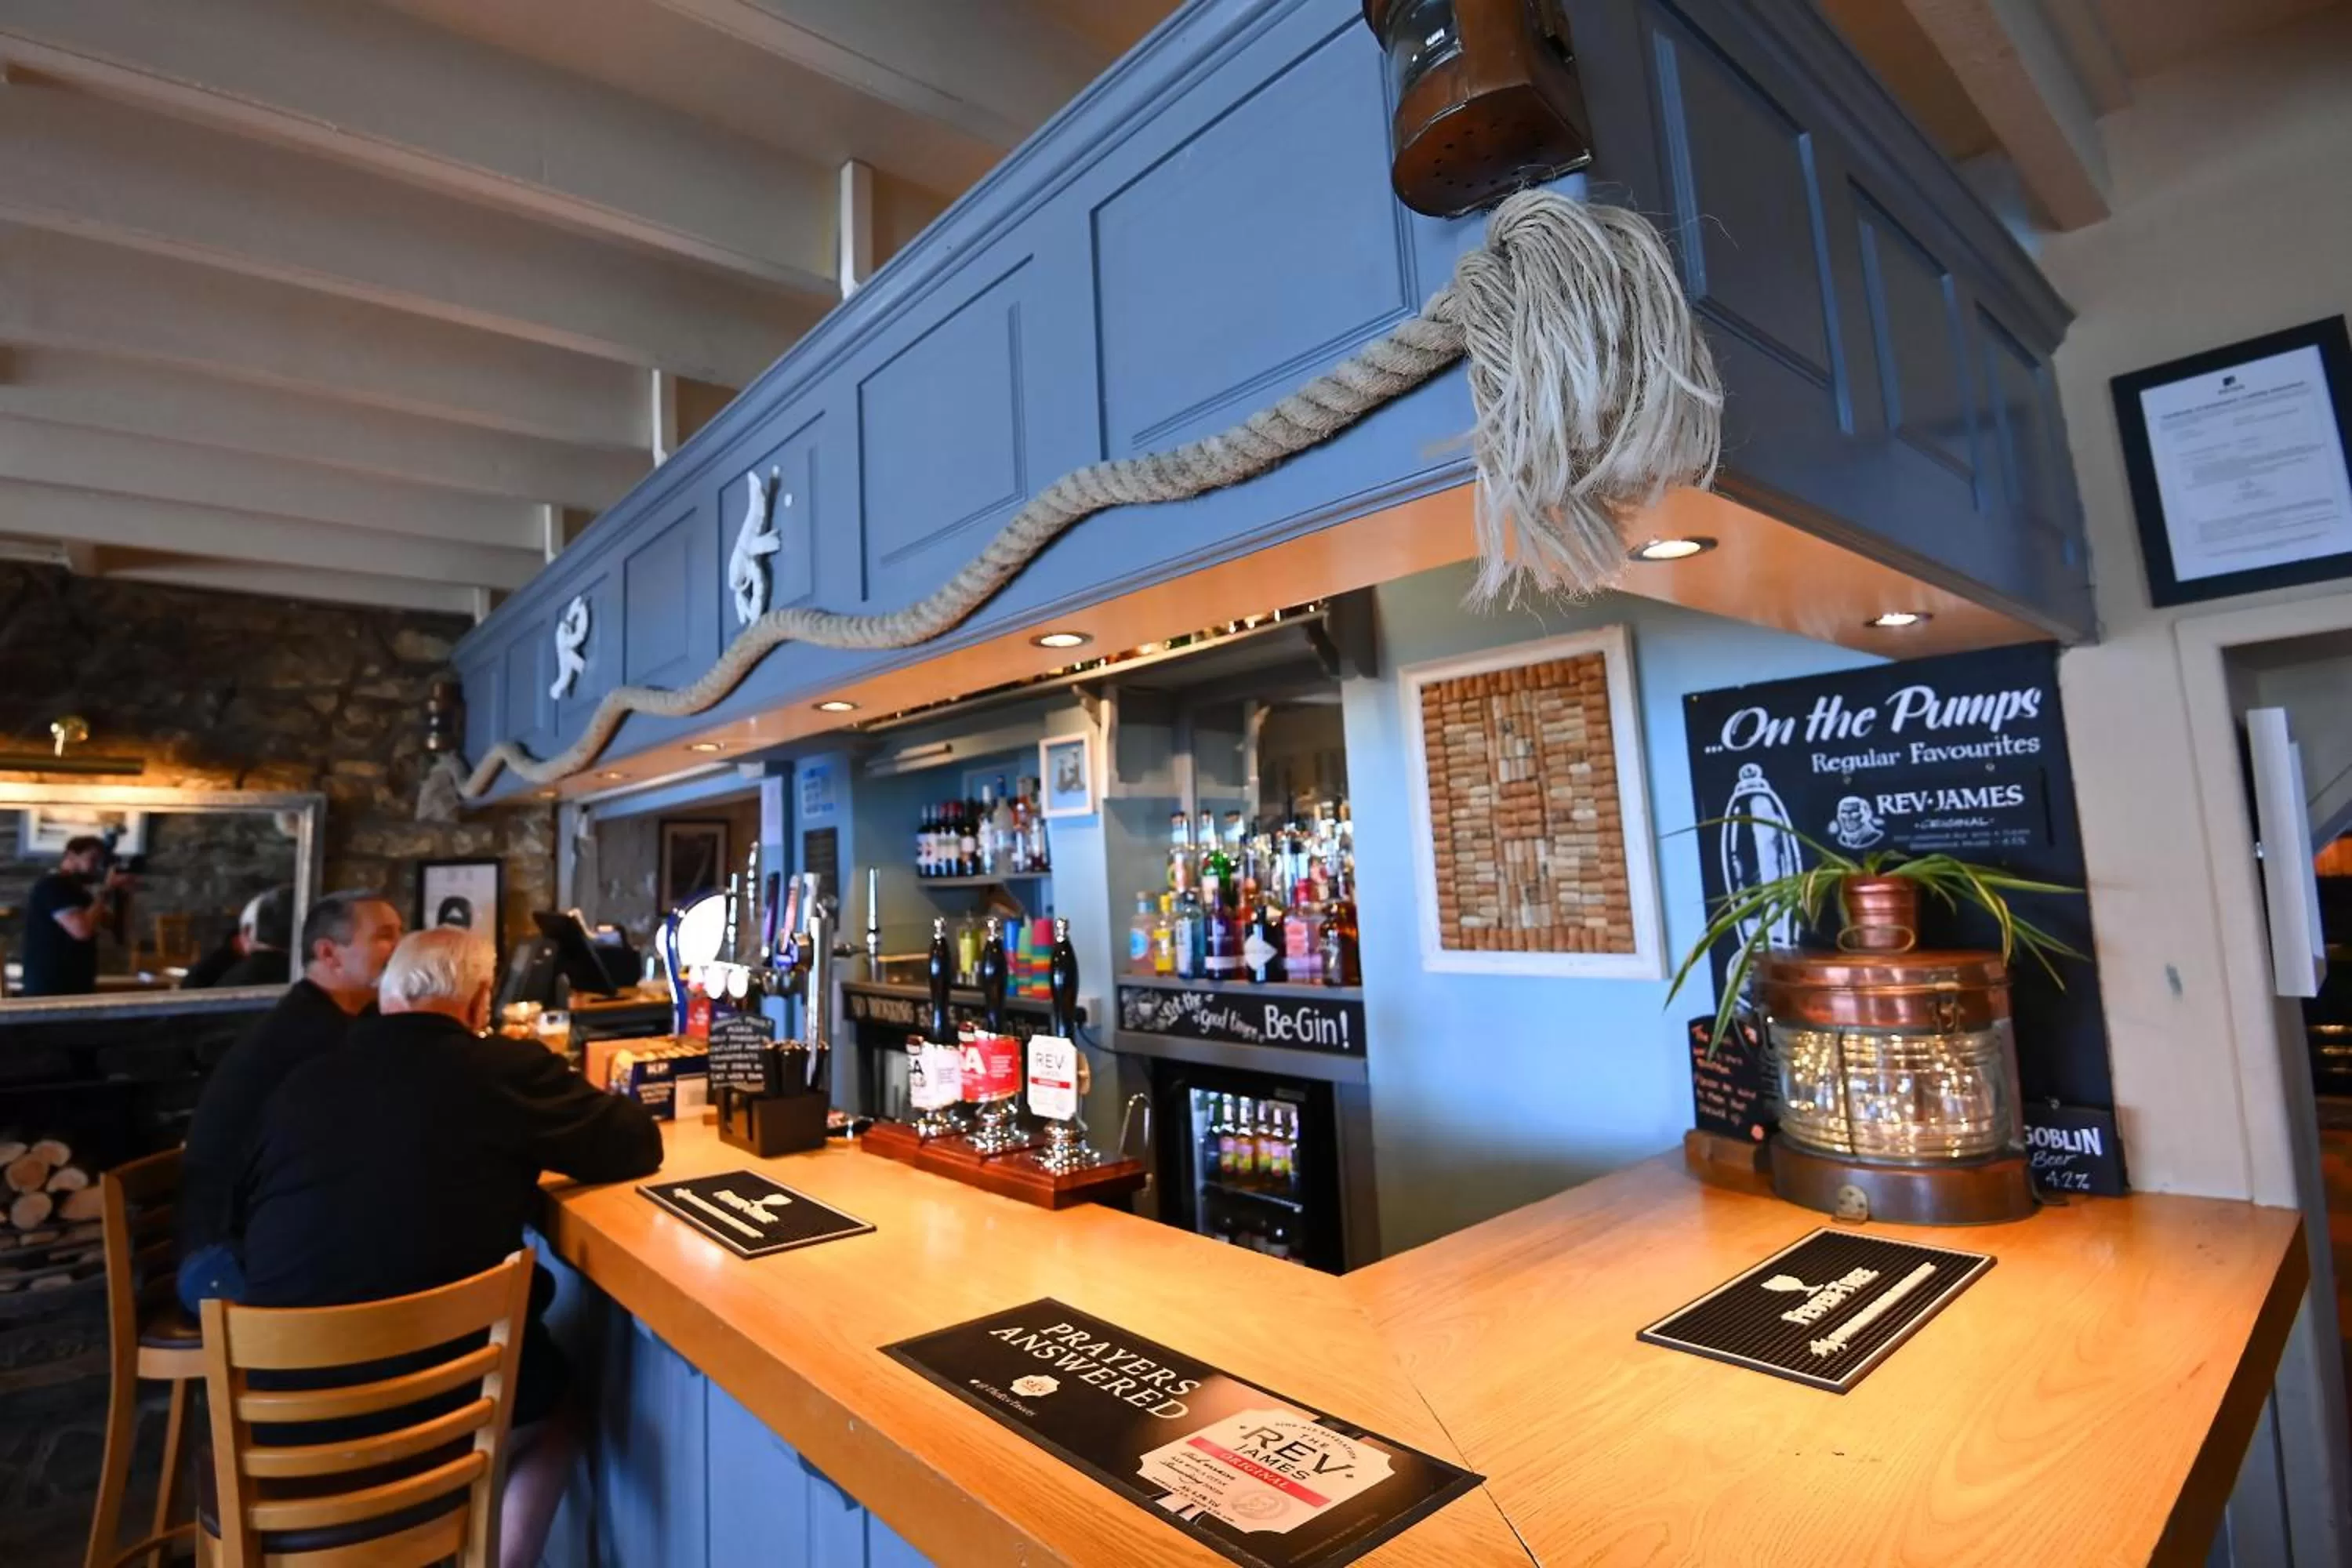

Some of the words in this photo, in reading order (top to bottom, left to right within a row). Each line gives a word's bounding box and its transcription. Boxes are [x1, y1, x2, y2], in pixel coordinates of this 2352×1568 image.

[1805, 695, 1877, 743] the
[1886, 685, 2042, 732] Pumps
[1812, 750, 1900, 774] Regular
[1910, 735, 2040, 765] Favourites
[1036, 1052, 1065, 1070] REV
[989, 1327, 1189, 1419] ANSWERED
[1040, 1323, 1202, 1396] PRAYERS
[1241, 1426, 1355, 1476] REV
[1300, 1433, 1330, 1448] THE
[1218, 1451, 1290, 1490] ORIGINAL
[1233, 1443, 1310, 1482] JAMES
